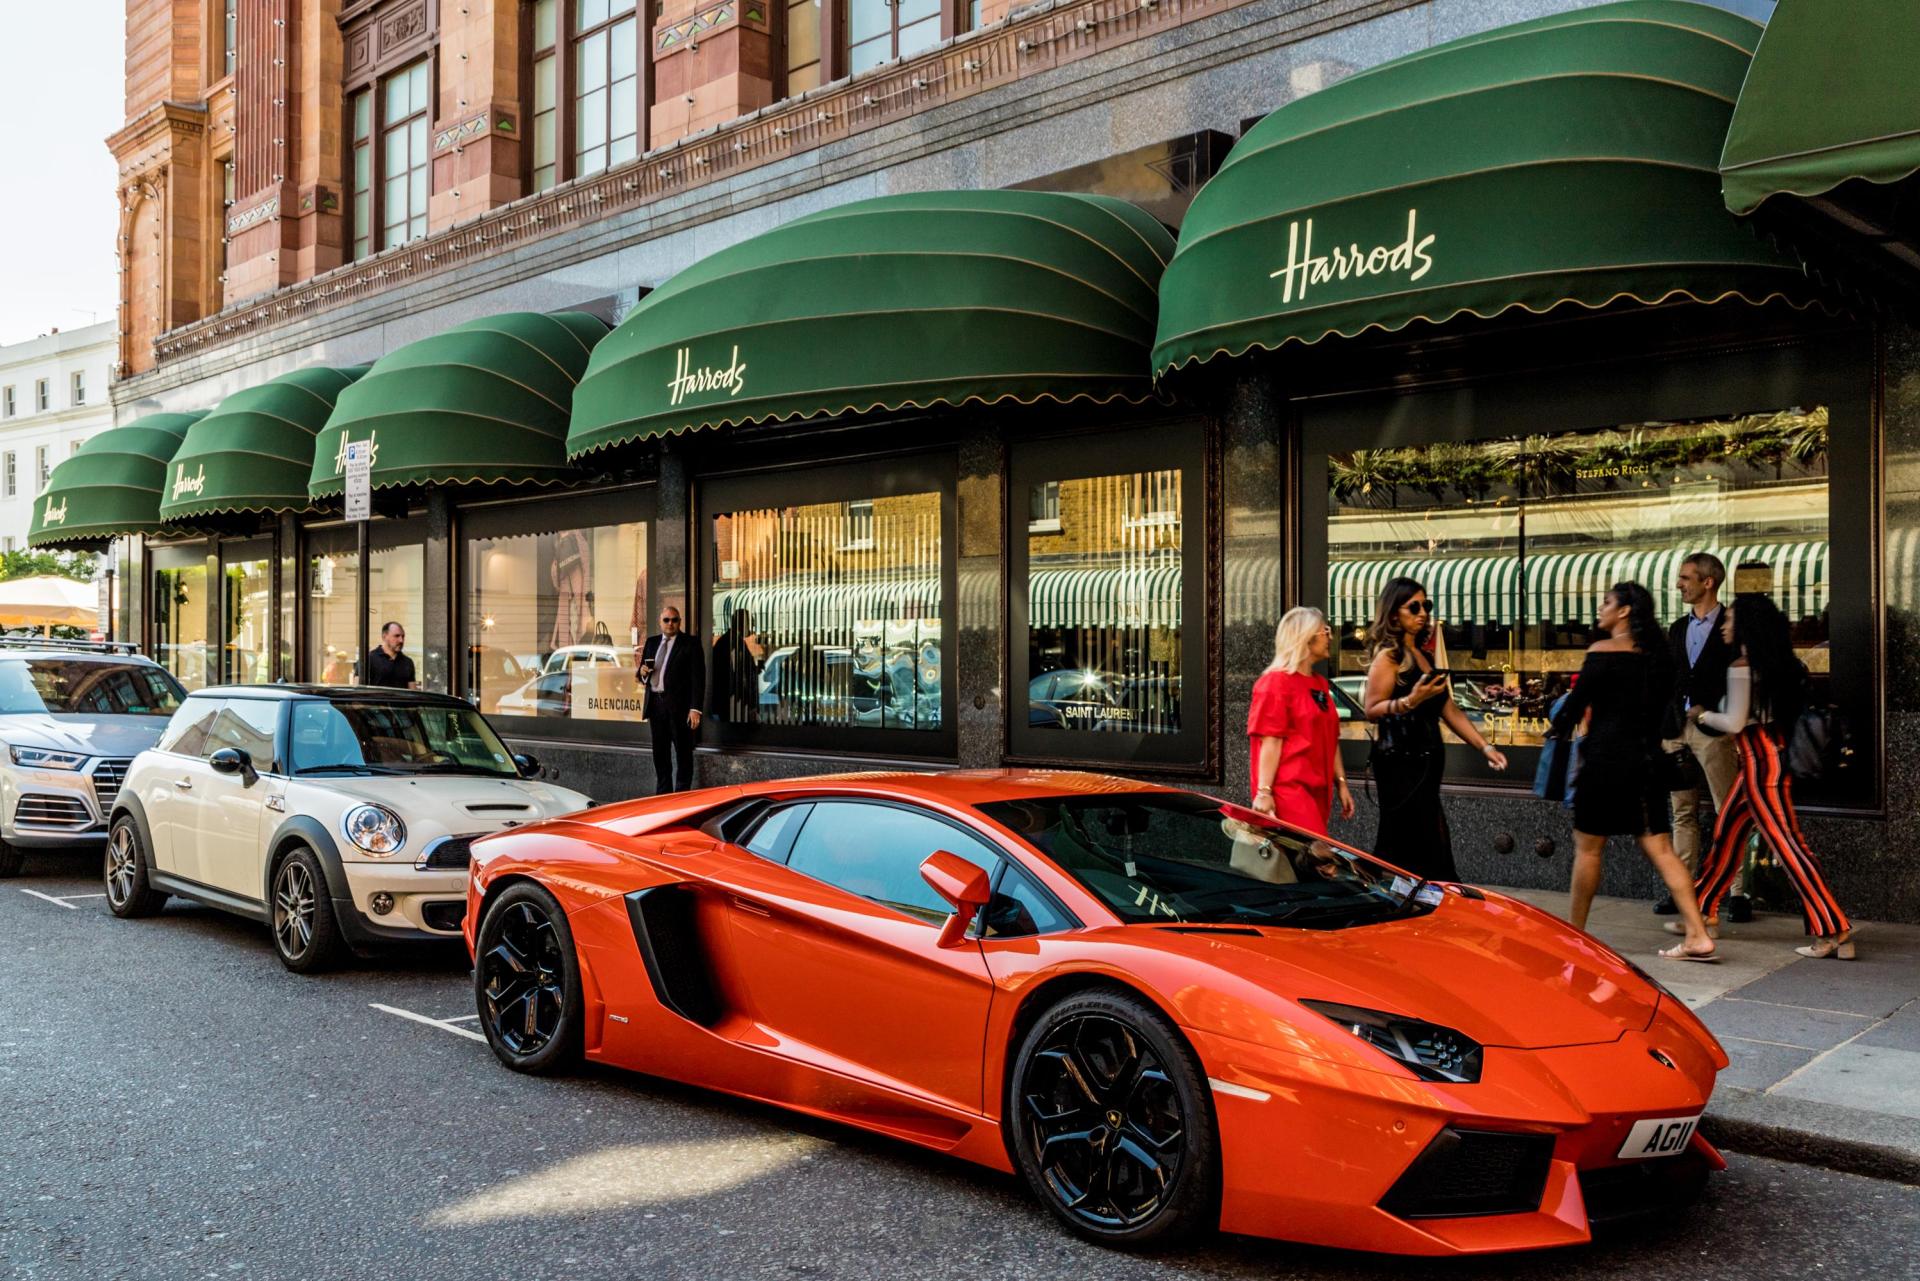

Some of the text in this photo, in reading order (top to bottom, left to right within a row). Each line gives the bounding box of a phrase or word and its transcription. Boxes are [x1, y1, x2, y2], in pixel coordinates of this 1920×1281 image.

[1269, 208, 1436, 304] Harrods
[667, 345, 747, 406] Harrods
[1576, 464, 1649, 479] STEFANO RICCI
[172, 463, 206, 501] Harrods
[588, 697, 642, 711] BALENCIAGA
[1065, 706, 1093, 719] SAINT
[1484, 712, 1553, 732] STEFAN
